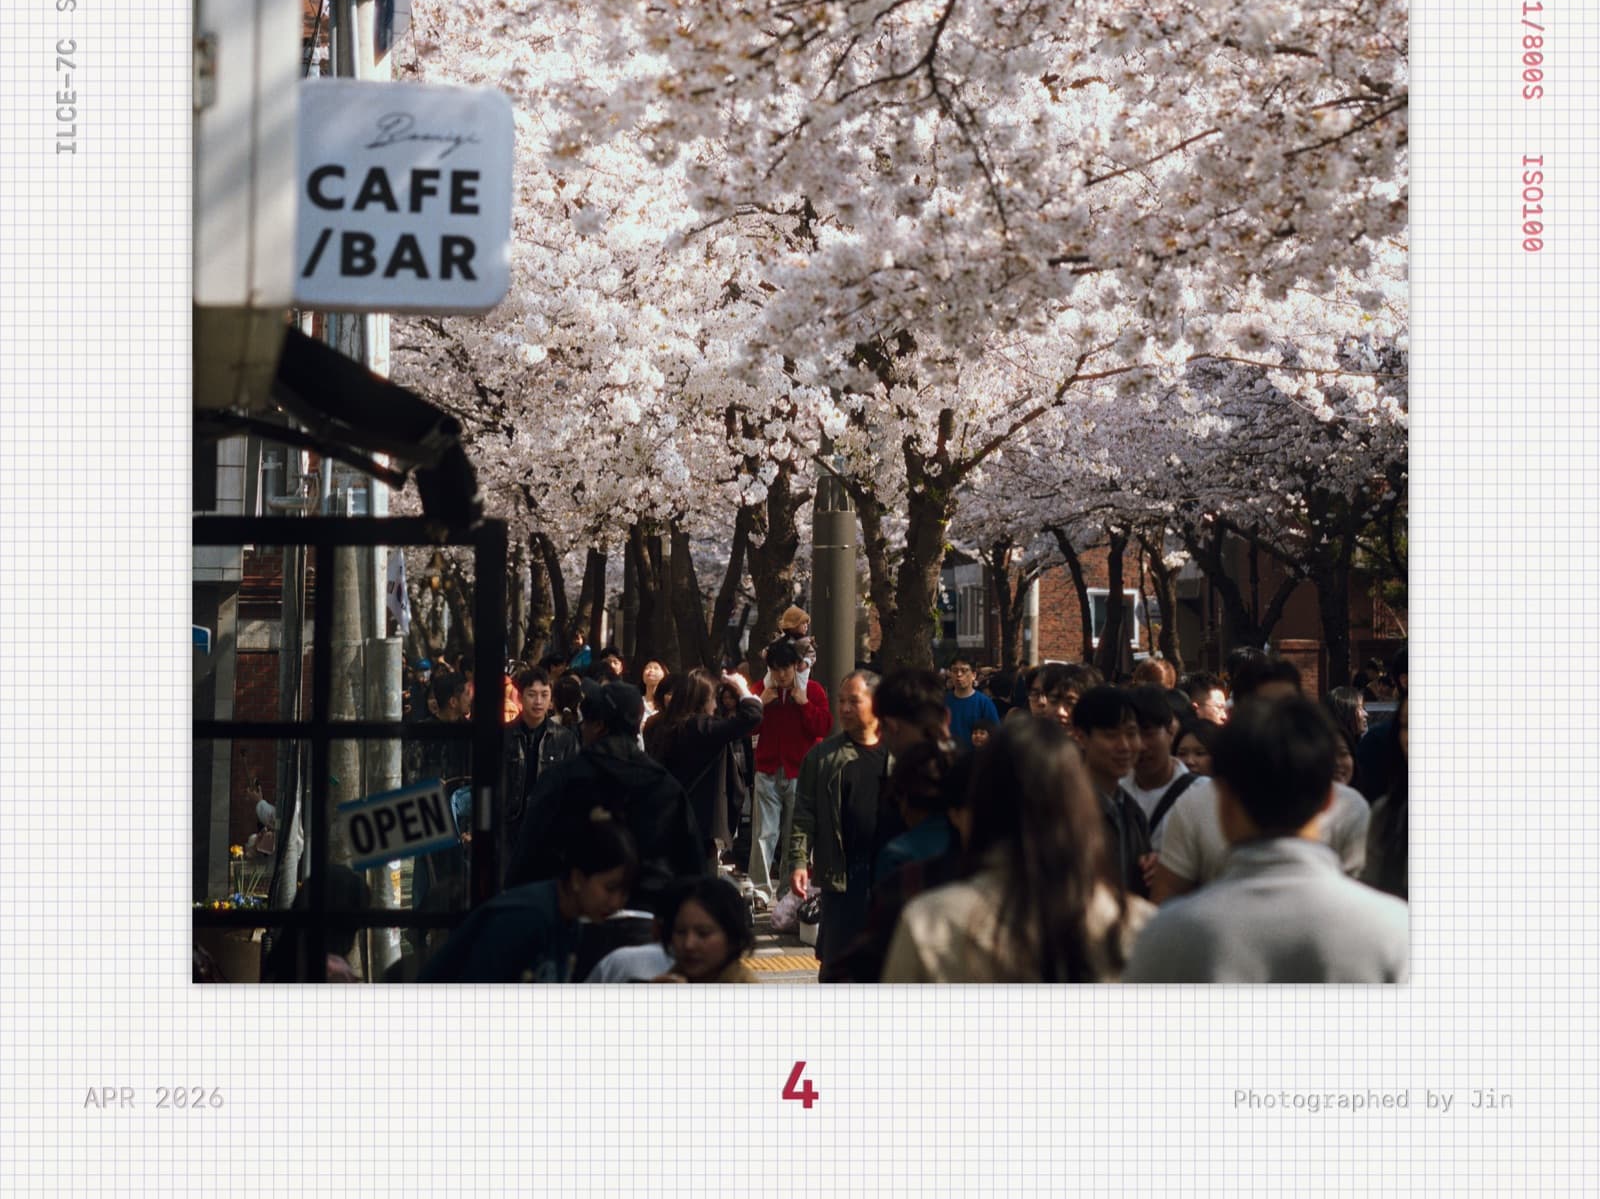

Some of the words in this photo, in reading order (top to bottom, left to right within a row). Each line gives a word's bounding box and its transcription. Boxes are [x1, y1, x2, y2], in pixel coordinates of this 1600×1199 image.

[306, 164, 480, 215] CAFE
[301, 227, 478, 281] /BAR
[350, 792, 447, 854] OPEN
